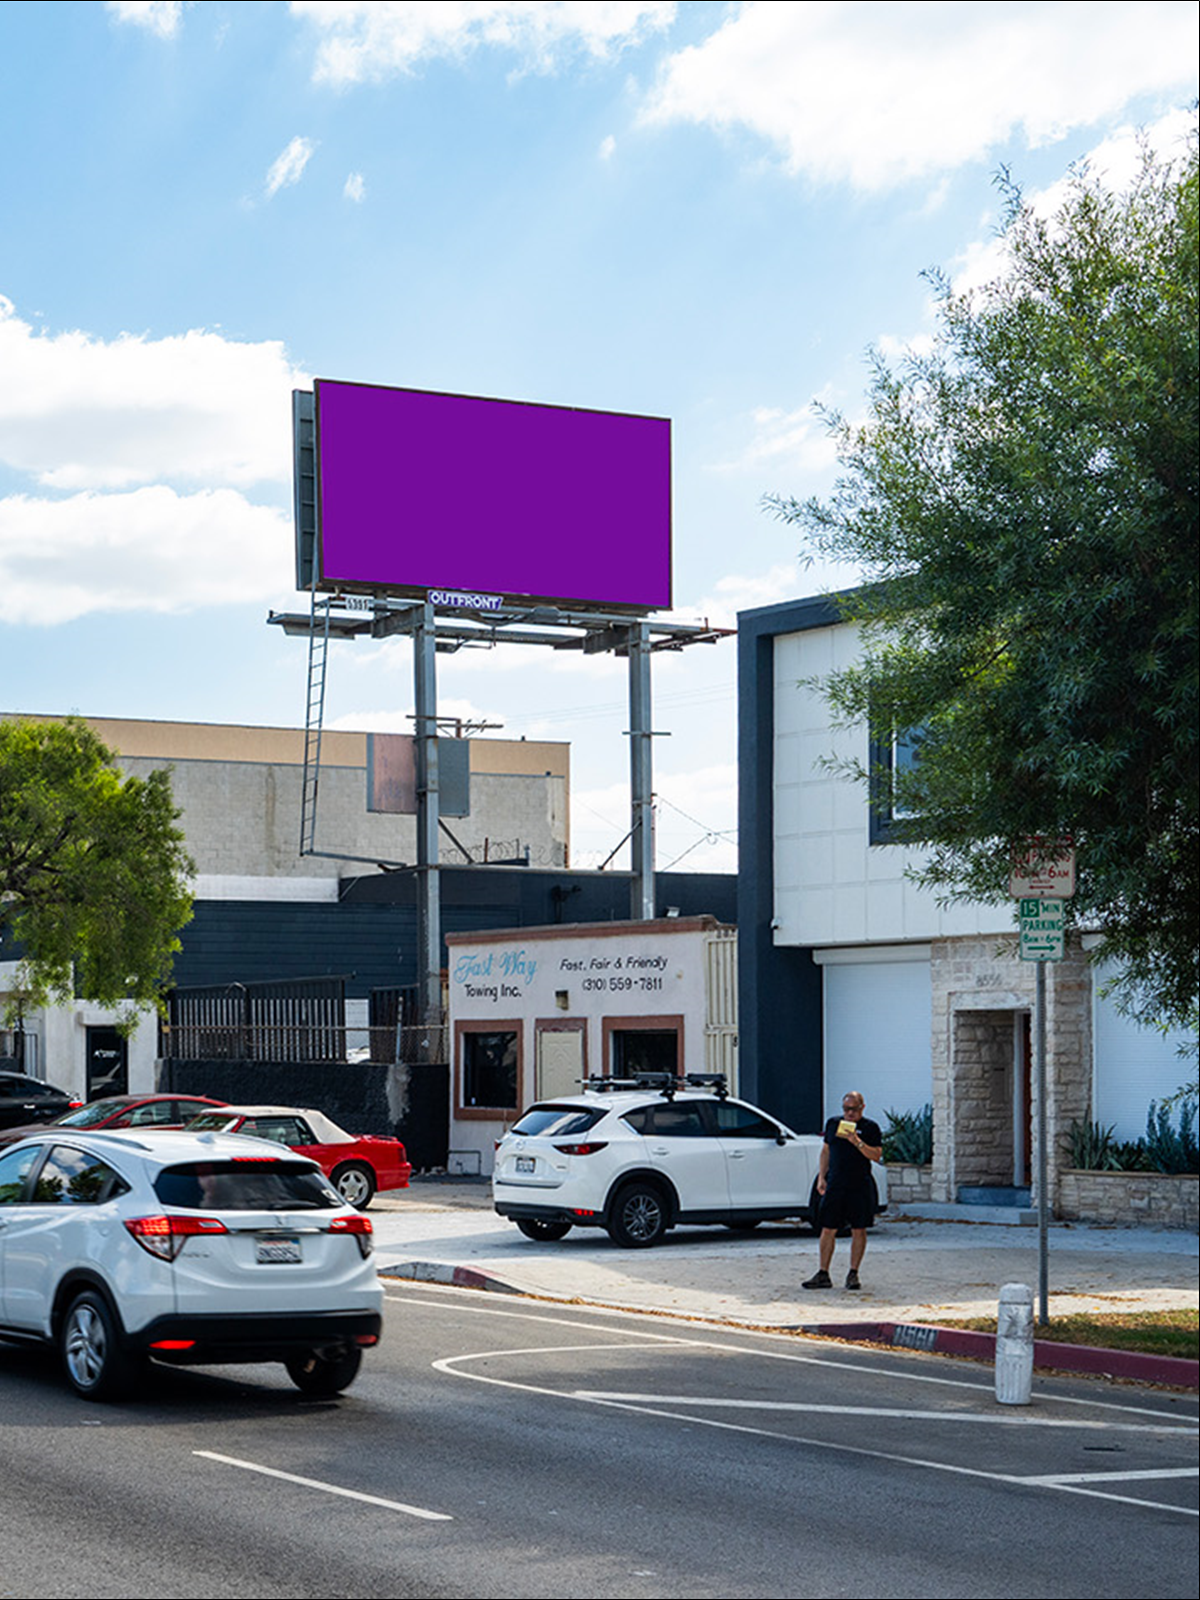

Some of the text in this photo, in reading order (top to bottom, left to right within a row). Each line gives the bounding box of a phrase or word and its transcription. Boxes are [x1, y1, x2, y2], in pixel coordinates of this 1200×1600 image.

[430, 592, 498, 609] OUTFRONT
[1023, 901, 1037, 916] 15
[1023, 919, 1062, 931] PARKING
[454, 950, 537, 985] Fast Way
[589, 957, 611, 969] Fair
[614, 957, 622, 969] &
[626, 955, 668, 971] Friendly
[464, 983, 522, 1002] Towing Inc.
[582, 978, 607, 991] (310)
